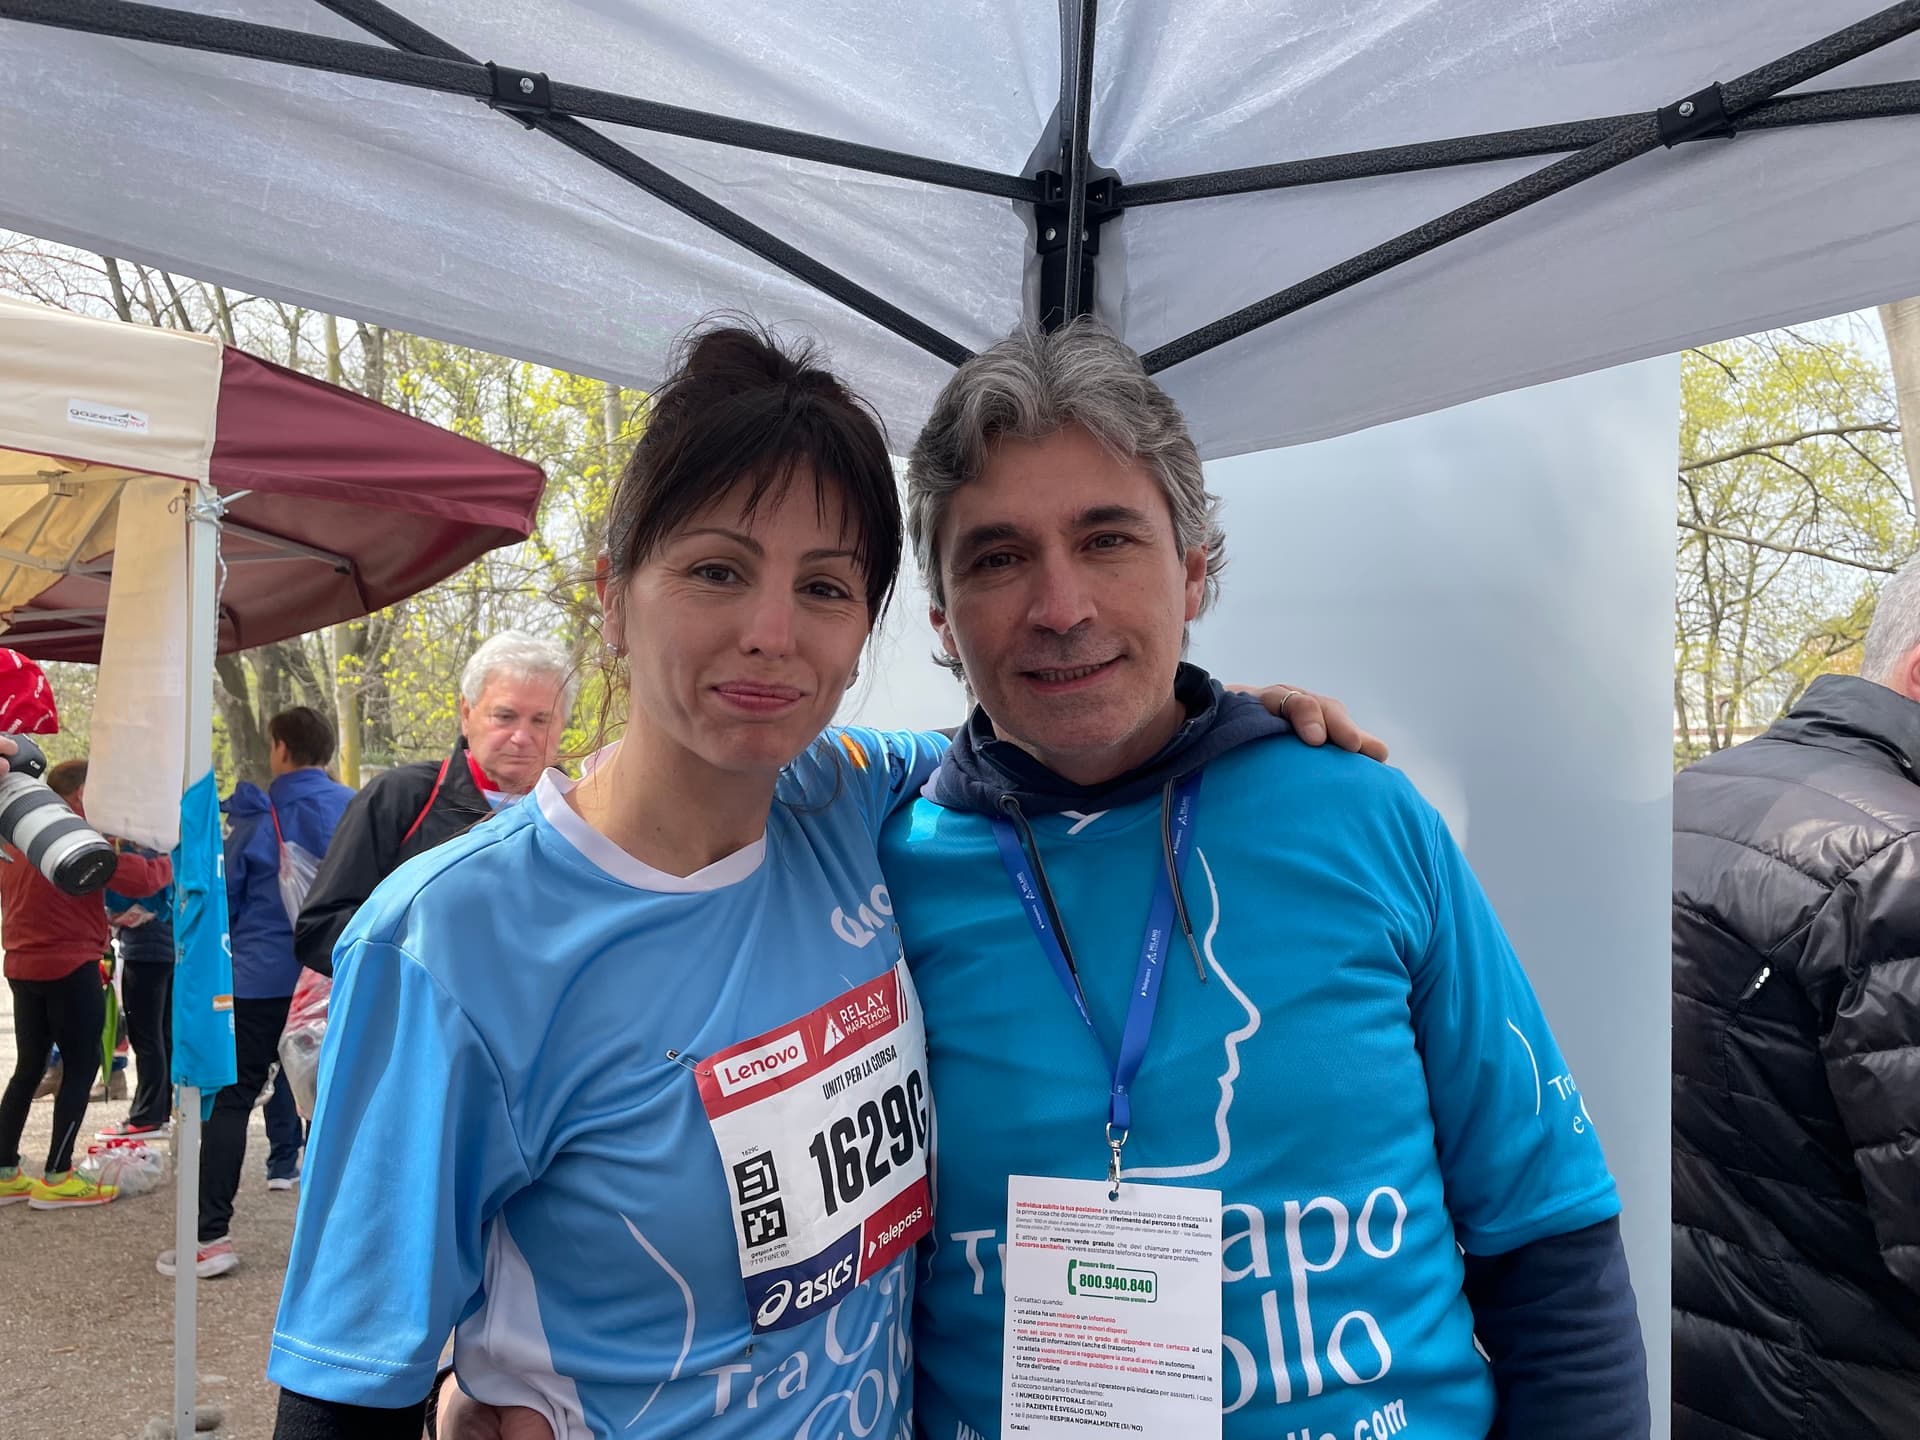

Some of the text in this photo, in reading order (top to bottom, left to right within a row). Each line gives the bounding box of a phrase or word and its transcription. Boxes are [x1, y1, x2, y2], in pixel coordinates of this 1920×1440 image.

[840, 989, 884, 1024] RELAY
[845, 1004, 890, 1036] MARATHON
[724, 1045, 799, 1085] Lenovo
[822, 1044, 898, 1100] UNITI PER LA CORSA
[809, 1069, 927, 1217] 1629C
[1573, 1116, 1585, 1134] e
[741, 1145, 759, 1158] 1629C
[877, 1206, 923, 1249] Telepass
[1222, 1186, 1407, 1320] apo
[795, 1253, 853, 1309] asics
[1080, 1273, 1152, 1293] 800.940.840
[1222, 1290, 1392, 1414] ollo
[699, 1351, 809, 1417] Tra
